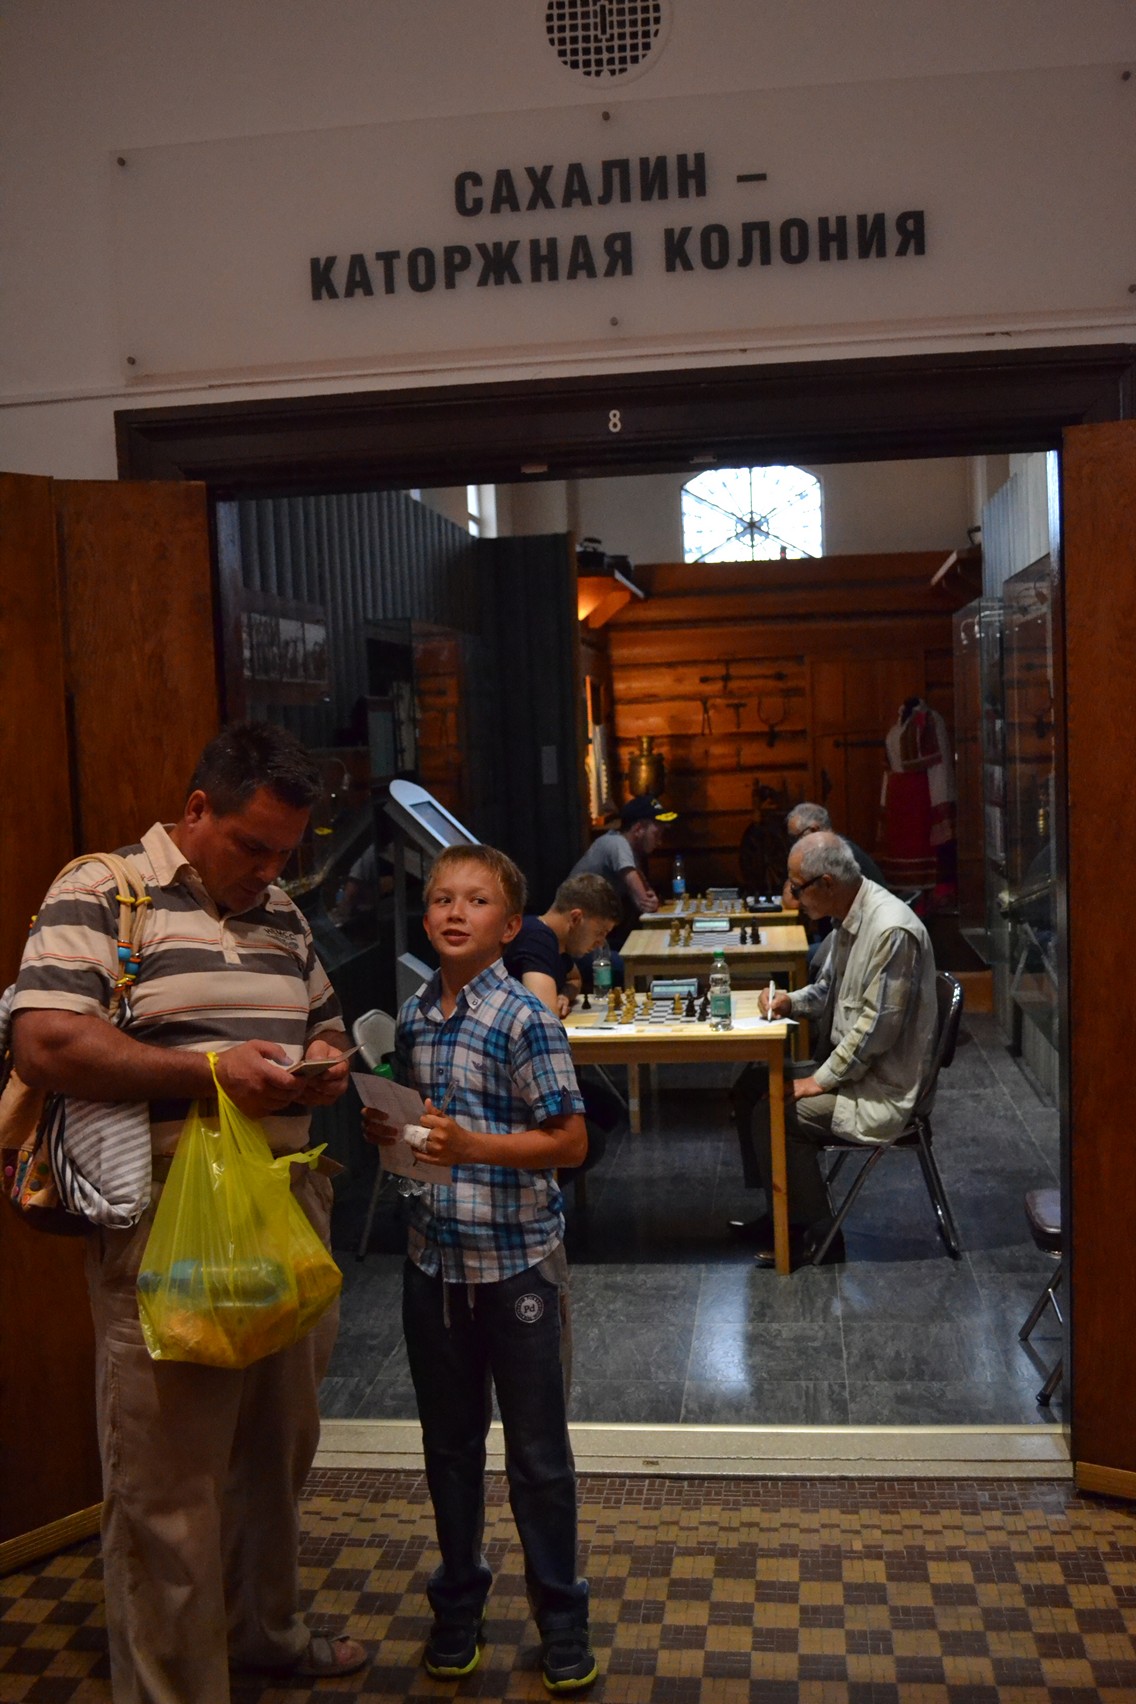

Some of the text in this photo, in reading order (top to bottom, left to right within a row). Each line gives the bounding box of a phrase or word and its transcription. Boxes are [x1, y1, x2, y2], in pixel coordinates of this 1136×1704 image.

[453, 151, 708, 218] САХАЛИН
[309, 209, 927, 302] КАТОРЖНАЯ КОЛОНИЯ
[609, 409, 622, 433] 8
